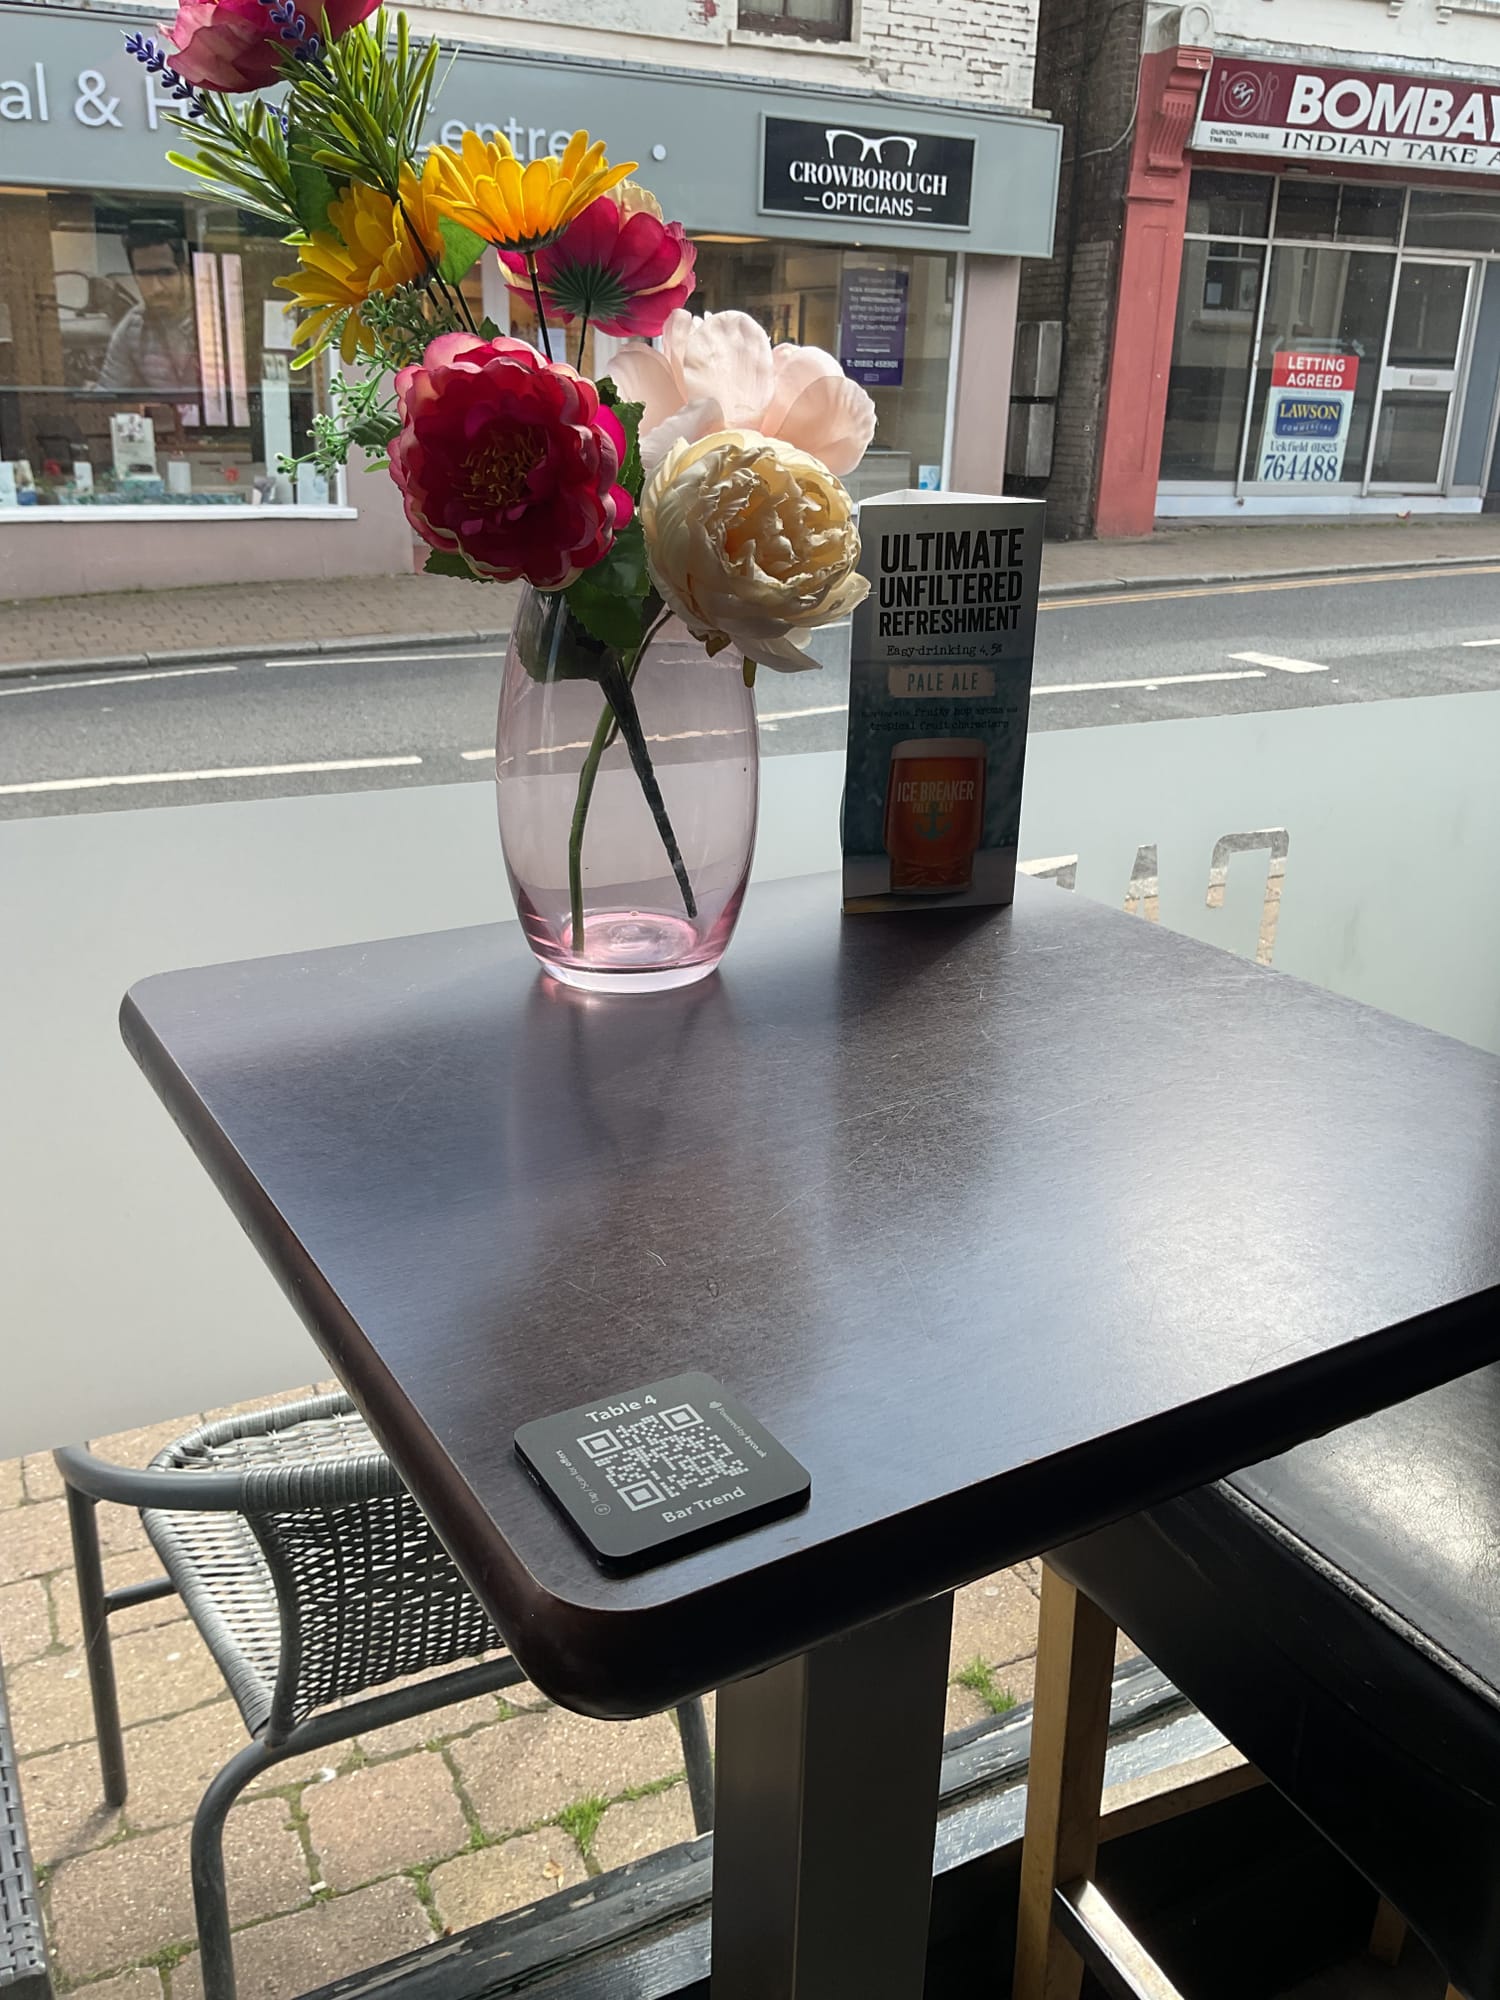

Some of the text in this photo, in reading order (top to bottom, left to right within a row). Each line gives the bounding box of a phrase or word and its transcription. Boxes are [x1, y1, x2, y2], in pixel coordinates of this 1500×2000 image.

[74, 69, 124, 129] &
[412, 102, 582, 162] entre
[1244, 131, 1270, 140] HOUSE
[1282, 131, 1391, 158] INDIAN
[1403, 142, 1479, 165] TAKE
[788, 160, 949, 196] CROWBOROUGH
[821, 191, 915, 217] OPTICIANS
[1287, 355, 1345, 372] LETTING
[1286, 373, 1343, 388] AGREED
[1280, 403, 1340, 420] LAWSON
[1270, 440, 1308, 452] Uckfield
[1263, 454, 1338, 481] 764488
[880, 528, 1025, 574] ULTIMATE
[879, 571, 1023, 608] UNFILTERED
[879, 605, 1021, 637] REFRESHMENT
[907, 672, 979, 691] PALE ALE
[897, 780, 975, 803] ICE BREAKER
[585, 1394, 657, 1423] Table 4
[661, 1486, 747, 1523] Bar Trend
